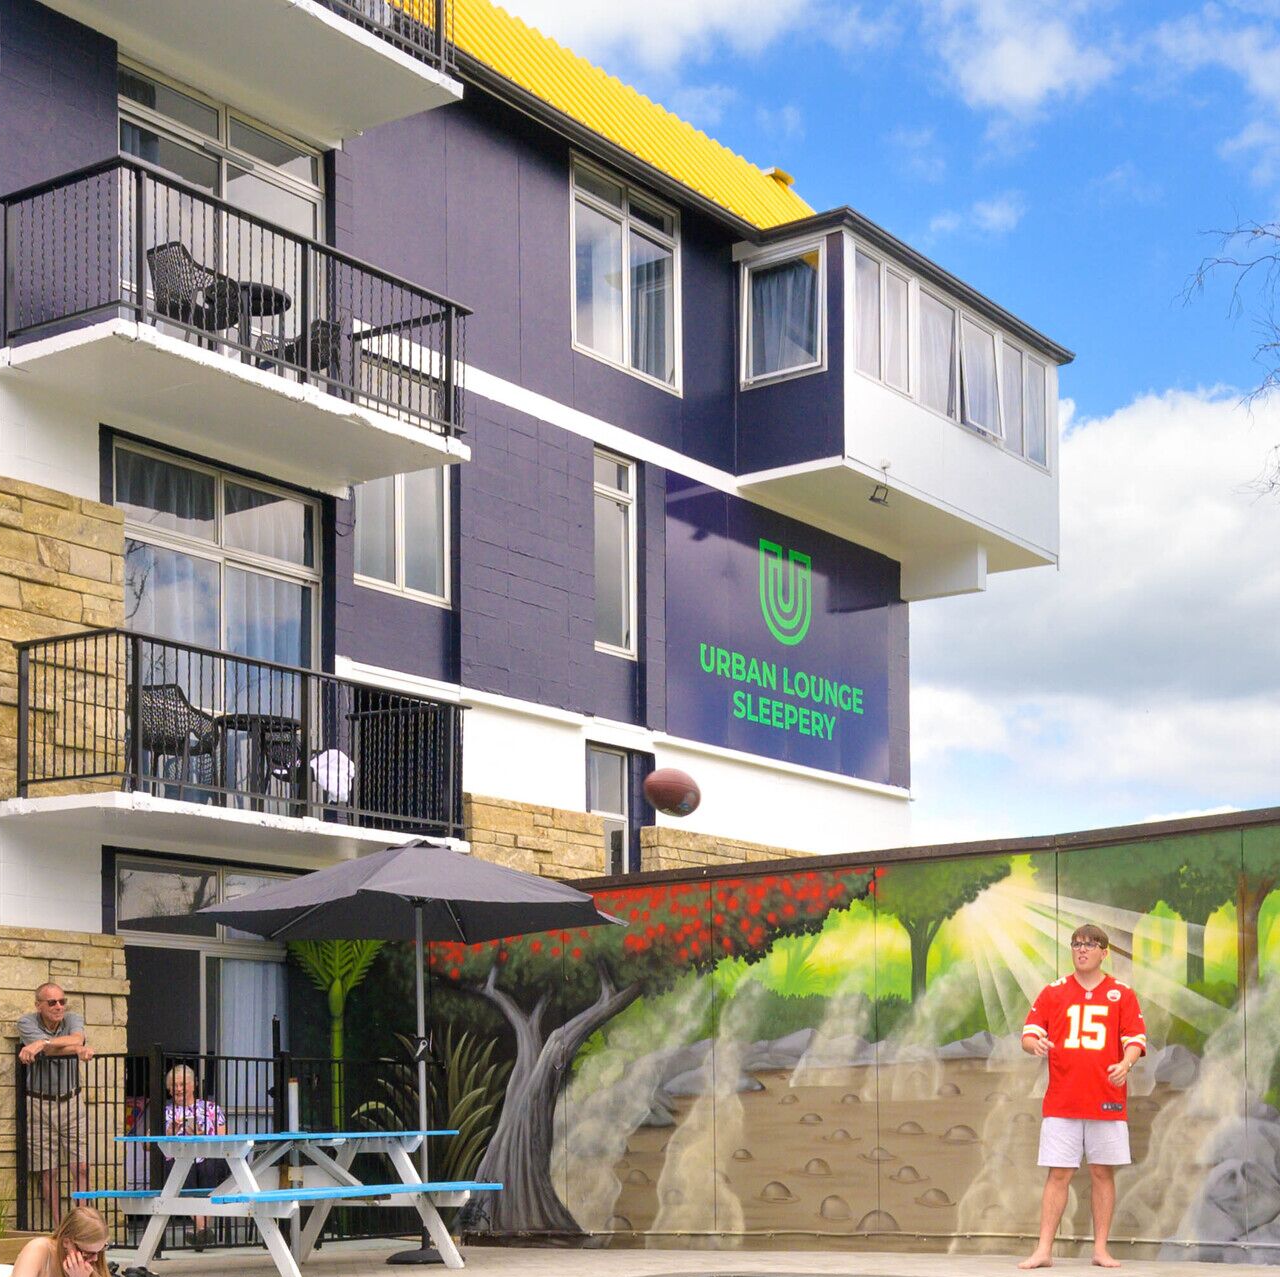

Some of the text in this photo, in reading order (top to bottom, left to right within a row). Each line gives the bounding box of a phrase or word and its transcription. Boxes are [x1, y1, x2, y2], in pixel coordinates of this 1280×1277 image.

[700, 643, 864, 714] URBAN LOUNGE
[733, 691, 836, 740] SLEEPERY
[1064, 1004, 1109, 1050] 15
